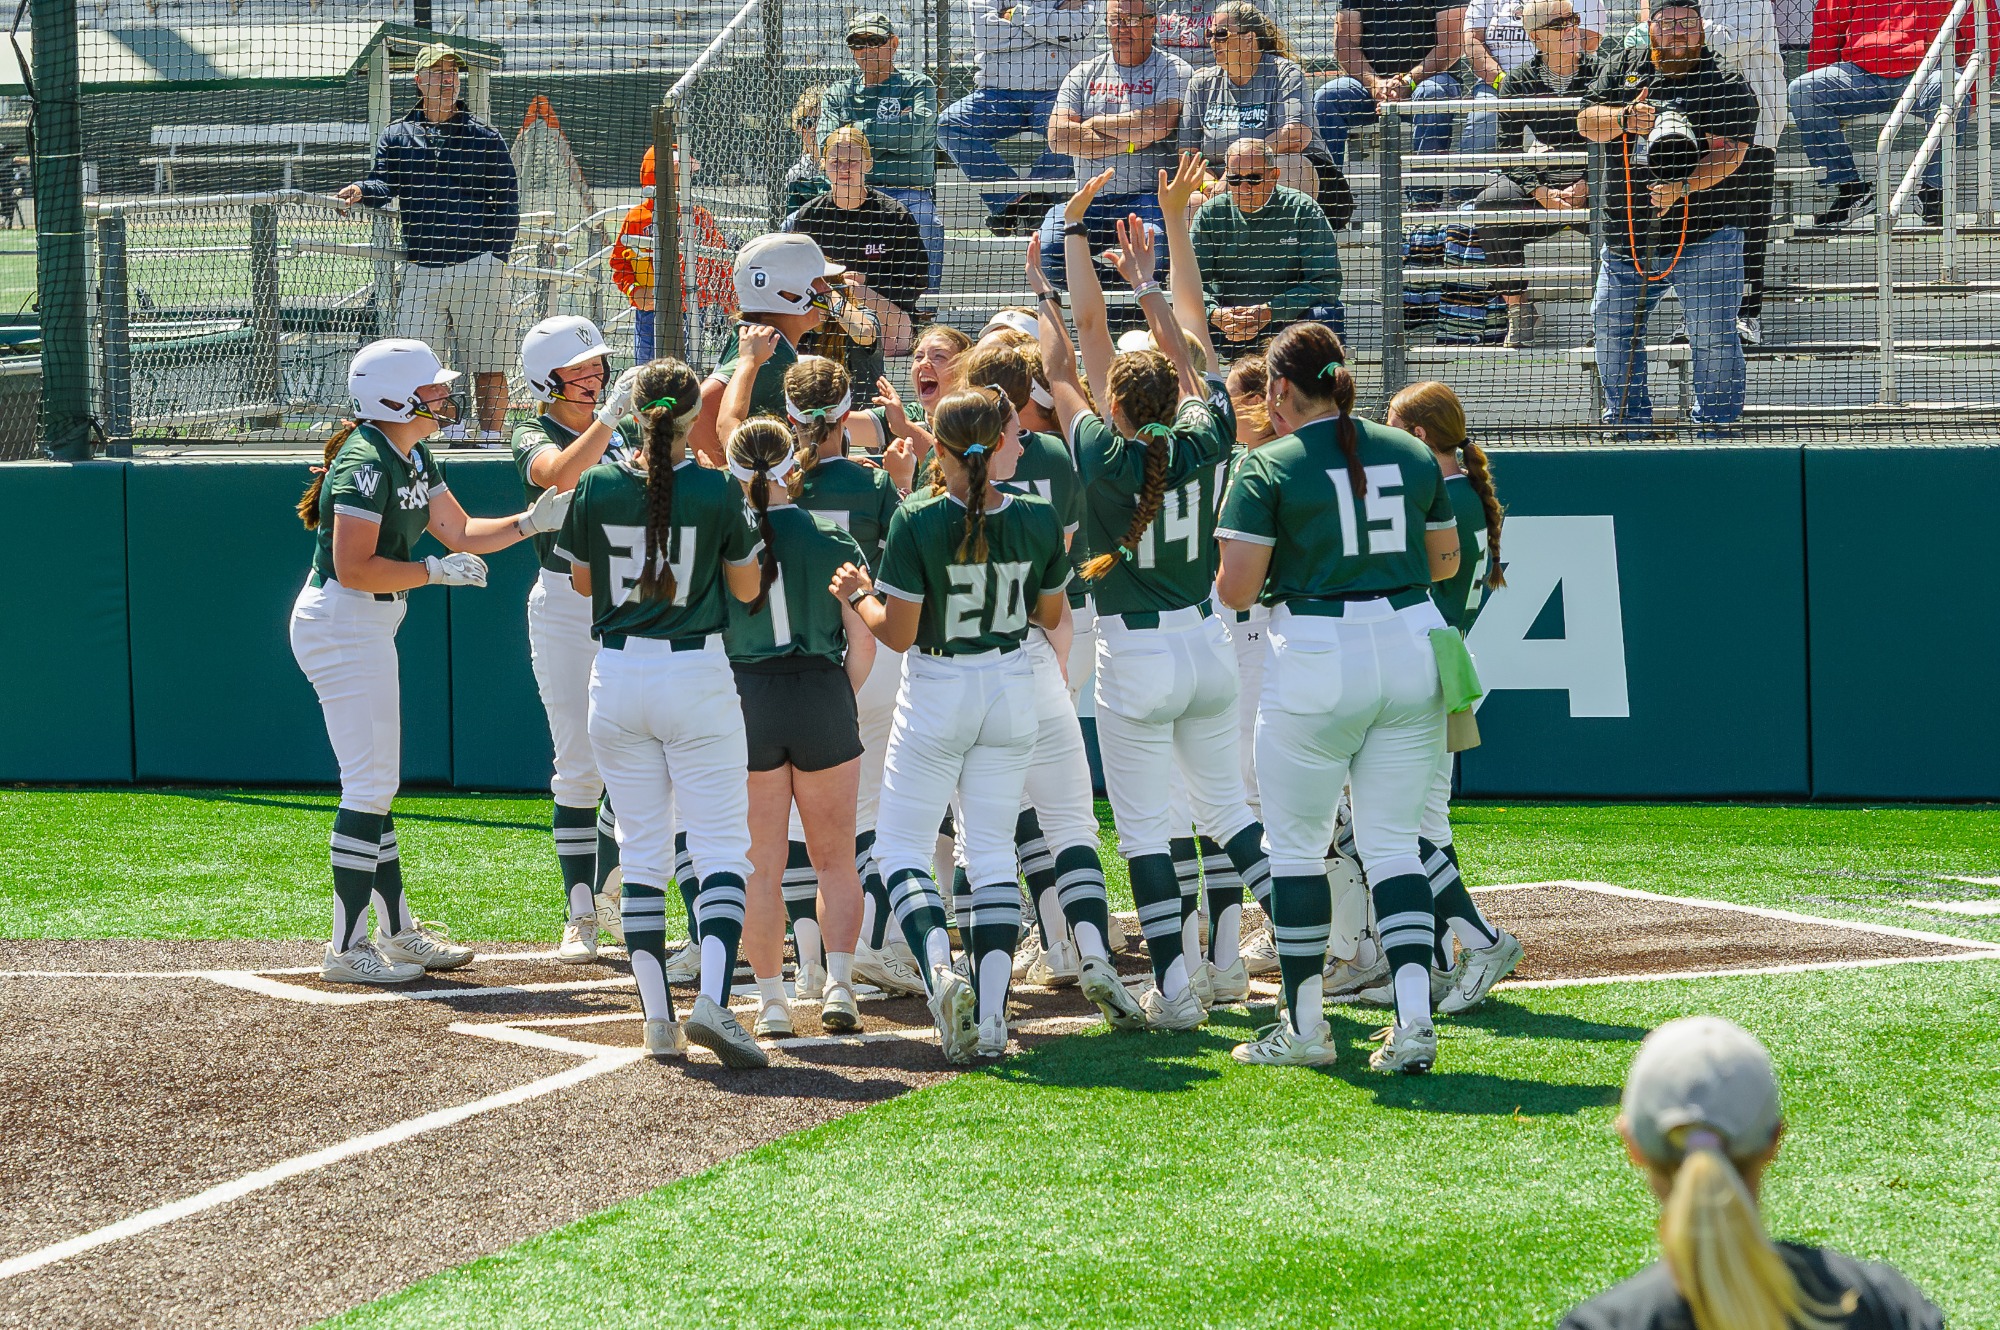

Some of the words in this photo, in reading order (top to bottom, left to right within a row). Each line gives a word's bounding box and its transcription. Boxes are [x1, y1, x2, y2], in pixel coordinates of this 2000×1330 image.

[1089, 79, 1153, 97] VIKINGS
[1203, 108, 1268, 122] CHAMPIONS
[1134, 478, 1201, 569] 14
[1325, 463, 1407, 557] 15
[601, 523, 697, 608] 24
[945, 561, 1032, 642] 20
